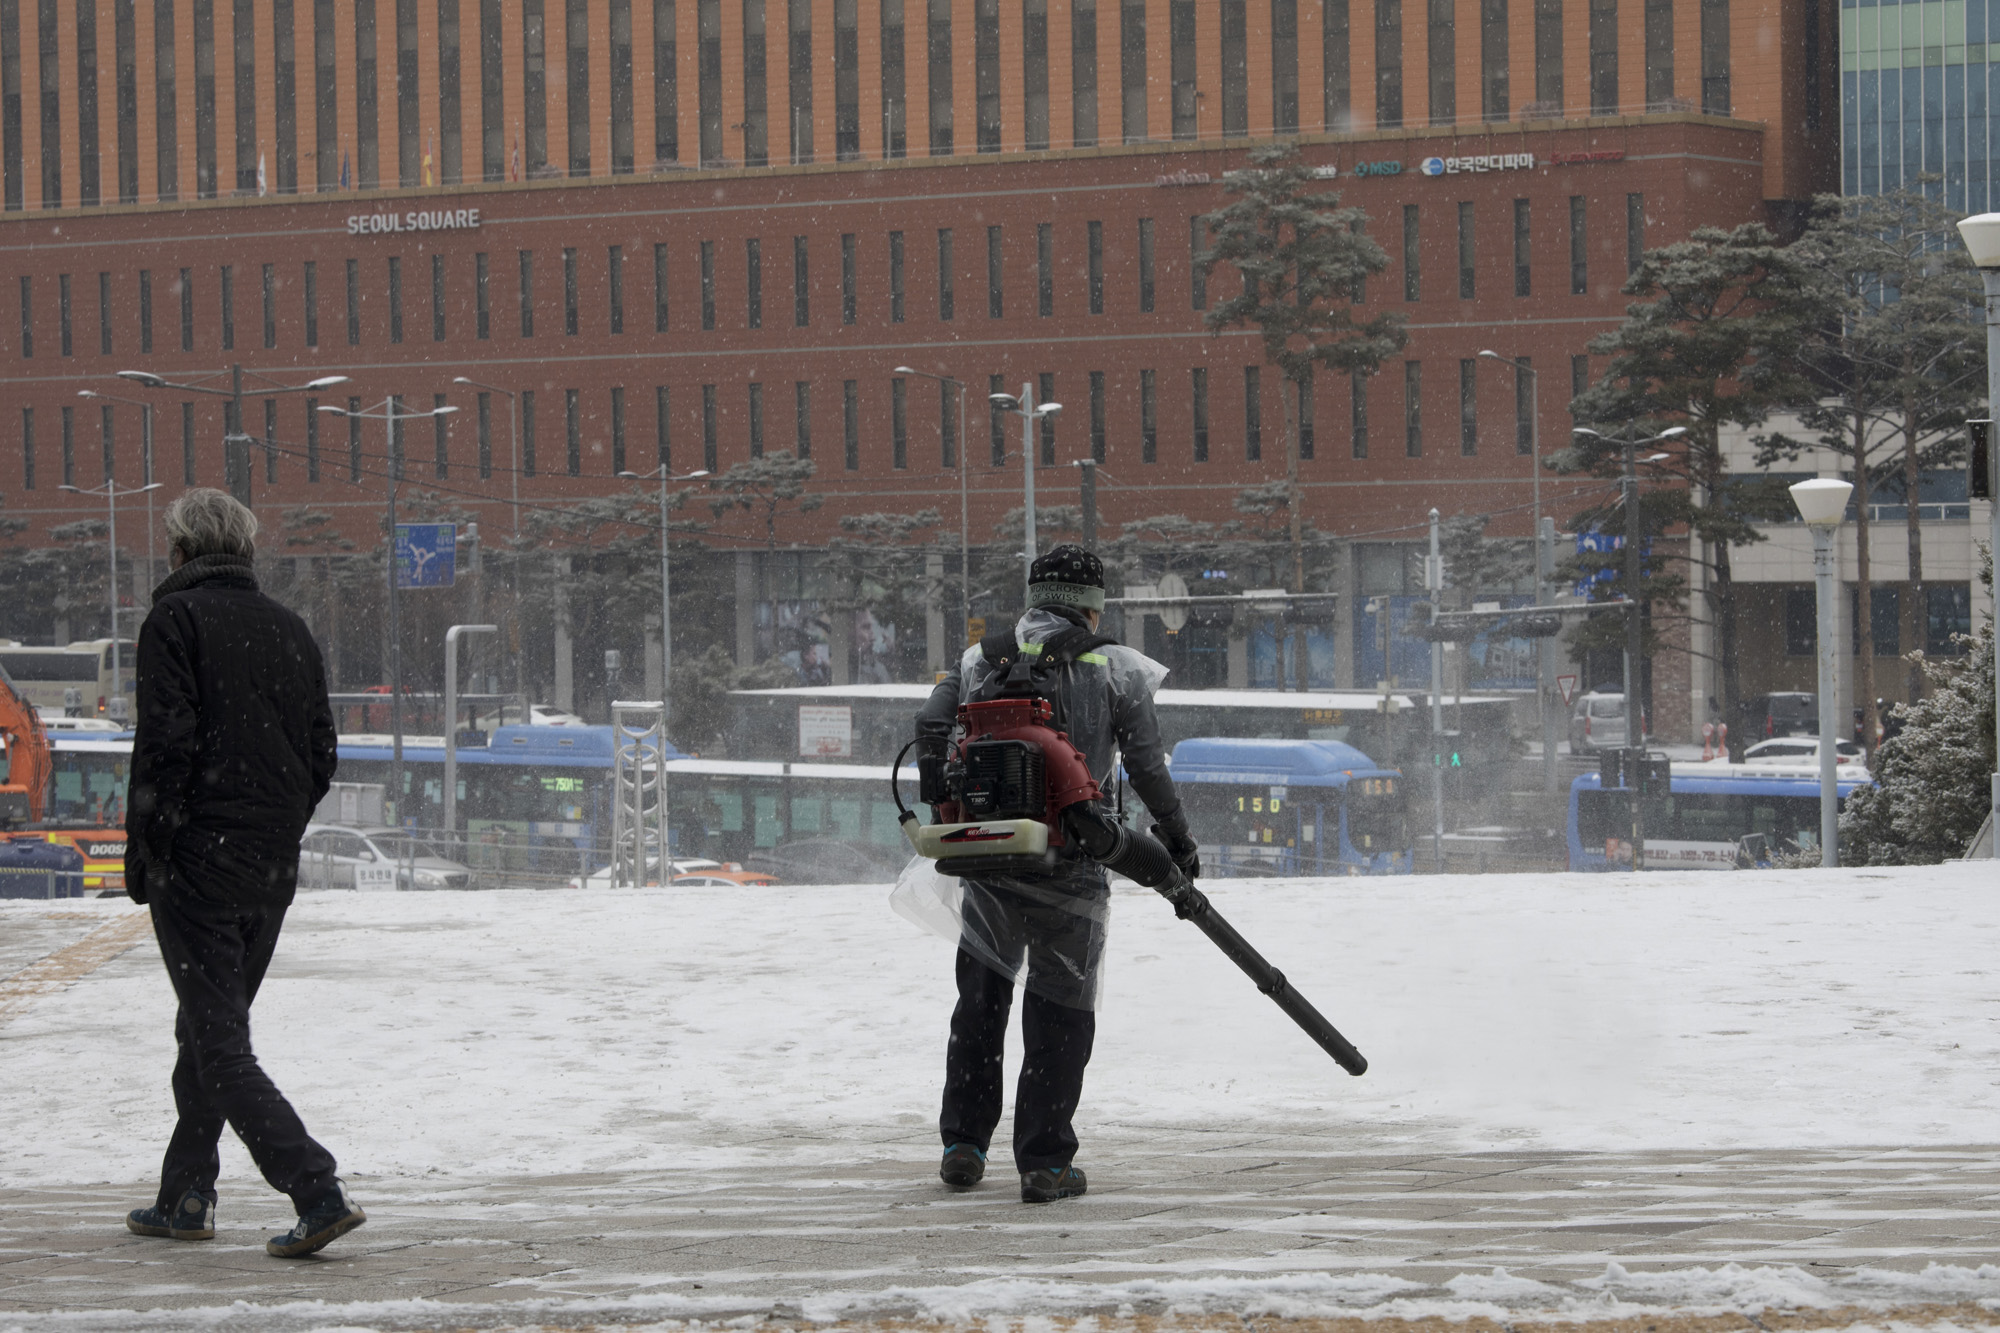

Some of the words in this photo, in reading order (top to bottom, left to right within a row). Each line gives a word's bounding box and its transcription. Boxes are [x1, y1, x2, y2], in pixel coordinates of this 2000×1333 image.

[1370, 161, 1401, 176] MSD
[1446, 153, 1533, 173] 한국먼디파마
[347, 213, 405, 234] SEOUL
[406, 208, 480, 231] SQUARE
[1032, 593, 1041, 602] OF
[1044, 592, 1079, 603] SWISS
[1237, 796, 1281, 813] 150
[90, 844, 127, 856] DOOS
